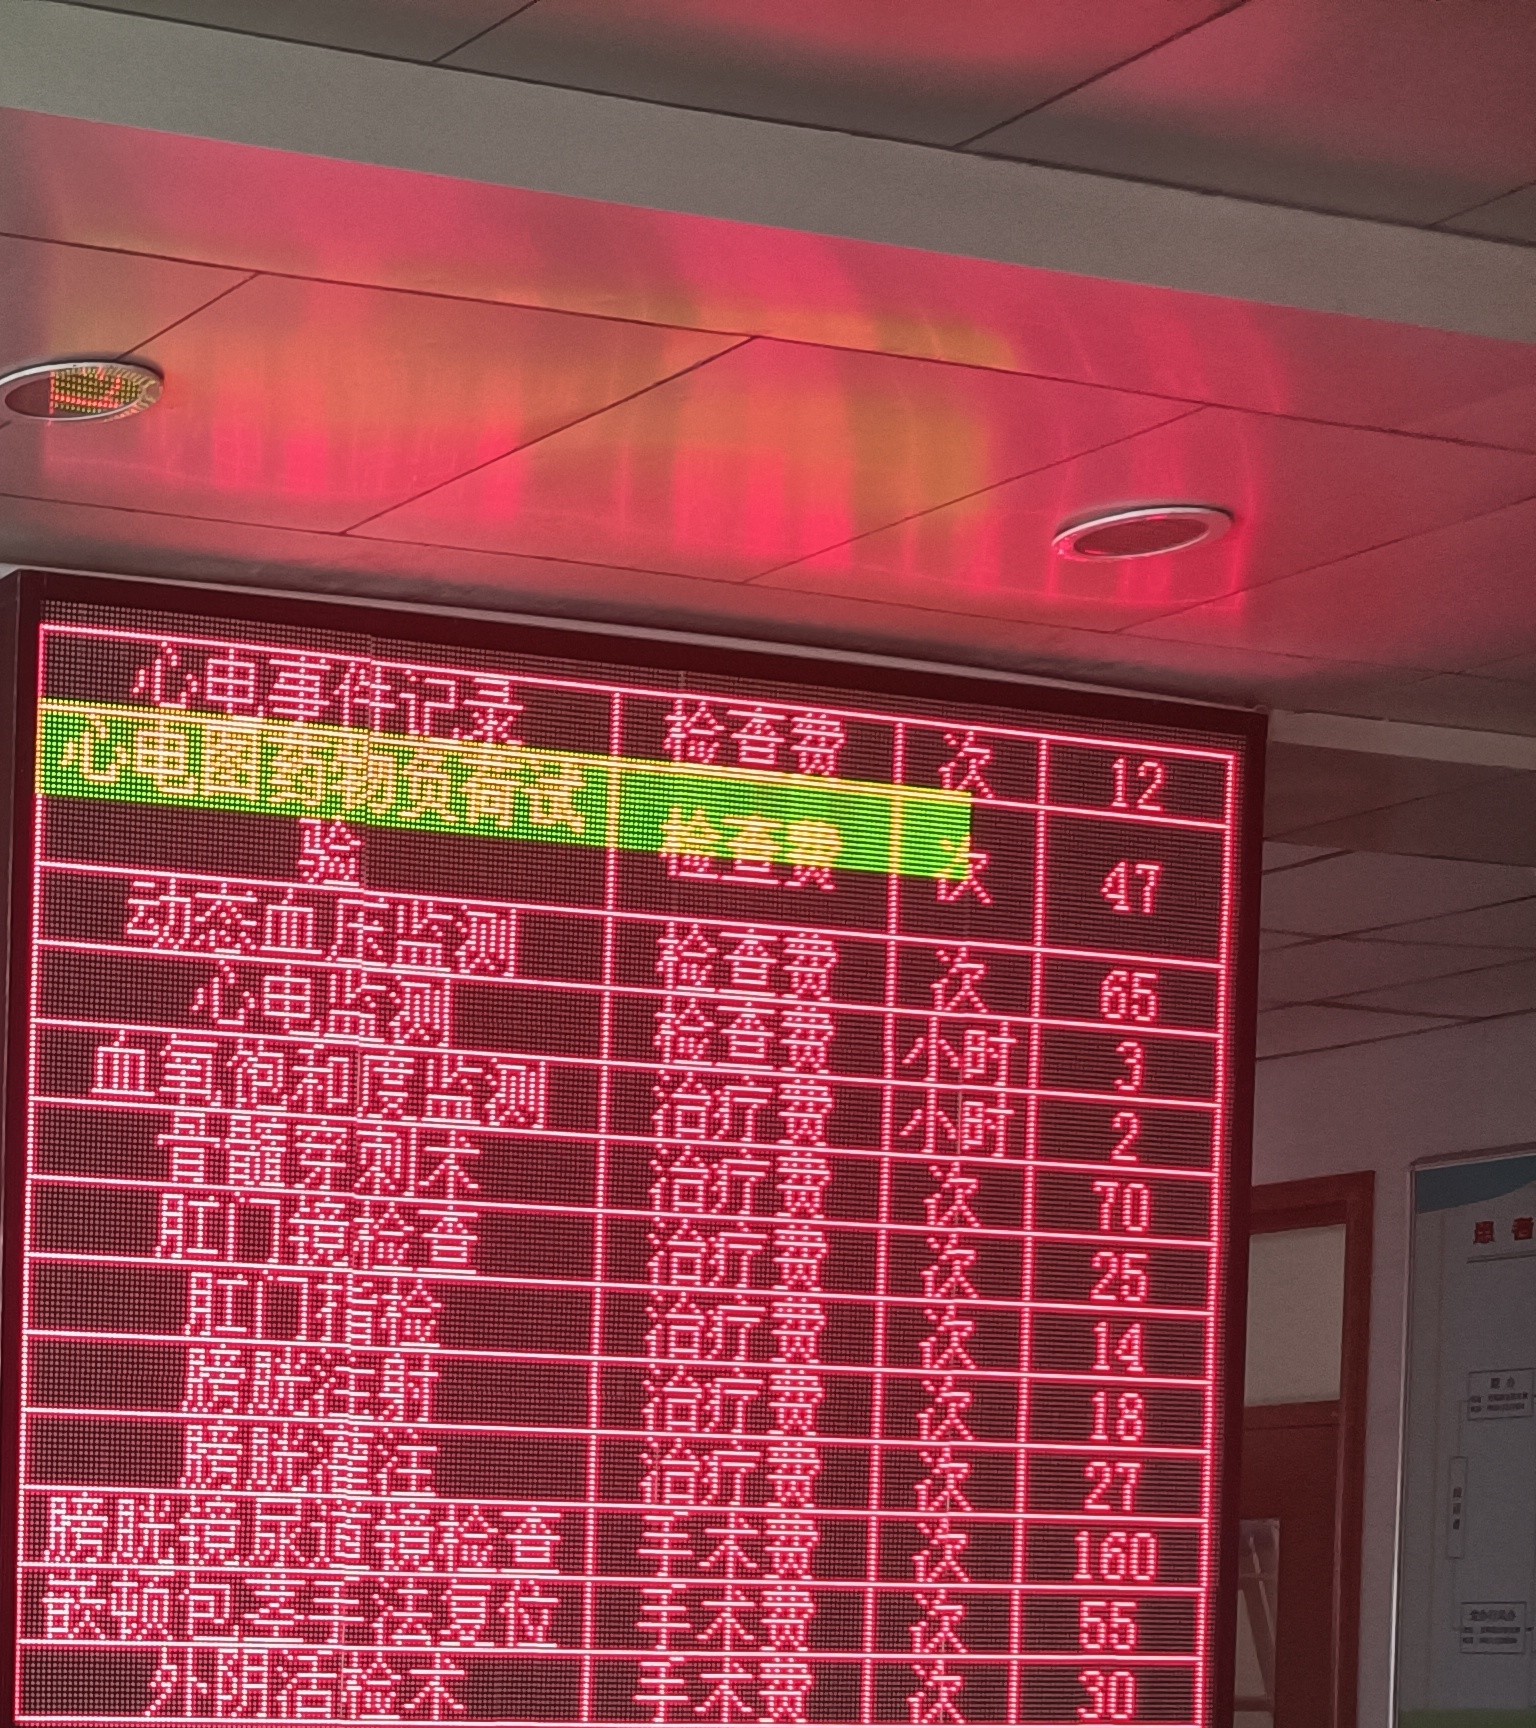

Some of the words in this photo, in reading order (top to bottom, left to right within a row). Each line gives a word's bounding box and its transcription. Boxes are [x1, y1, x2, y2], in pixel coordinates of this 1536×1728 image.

[132, 641, 525, 747] 心电事件记录
[663, 699, 846, 775] 检查费
[938, 731, 996, 802] 次
[1110, 757, 1166, 813] 12
[660, 806, 843, 890] 检查费
[935, 834, 992, 904] 次
[1100, 861, 1163, 915] 47
[127, 877, 519, 978] 动态血压监测
[657, 921, 838, 998] 检查费
[930, 945, 989, 1015] 次
[1099, 970, 1161, 1023] 65
[192, 959, 451, 1046] 心电监测
[654, 997, 836, 1070] 检查费
[902, 1014, 1018, 1095] 小时
[1114, 1041, 1146, 1094] 3
[90, 1030, 548, 1129] 血氧饱和度监测
[650, 1071, 833, 1144] 治疗费
[899, 1087, 1016, 1160] 小时
[1110, 1111, 1141, 1163] 2
[157, 1110, 480, 1197] 骨髓穿刺术
[649, 1144, 832, 1218] 治疗费
[924, 1160, 982, 1230] 次
[1092, 1181, 1152, 1234] 70
[155, 1194, 478, 1274] 肛门镜检查
[647, 1217, 828, 1291] 治疗费
[920, 1233, 981, 1300] 次
[1090, 1251, 1151, 1303] 25
[185, 1270, 441, 1348] 肛门指检
[645, 1291, 827, 1363] 治疗费
[918, 1303, 978, 1371] 次
[1092, 1320, 1146, 1373] 14
[182, 1346, 440, 1421] 膀胱注射
[642, 1362, 823, 1435] 治疗费
[915, 1374, 976, 1443] 次
[1090, 1391, 1146, 1443] 18
[180, 1421, 438, 1496] 膀胱灌注
[639, 1435, 822, 1506] 治疗费
[913, 1444, 976, 1513] 次
[1083, 1460, 1143, 1513] 27
[45, 1493, 561, 1574] 膀胱镜尿道镜检查
[637, 1509, 820, 1581] 手术费
[910, 1516, 972, 1585] 次
[1073, 1531, 1159, 1583] 160
[43, 1569, 559, 1648] 嵌顿包茎手法复位
[635, 1581, 816, 1653] 手术费
[909, 1587, 969, 1655] 次
[1078, 1601, 1138, 1650] 55
[145, 1647, 466, 1720] 外阴活检术
[634, 1655, 814, 1724] 手术费
[907, 1660, 967, 1725] 次
[1078, 1669, 1137, 1720] 30
